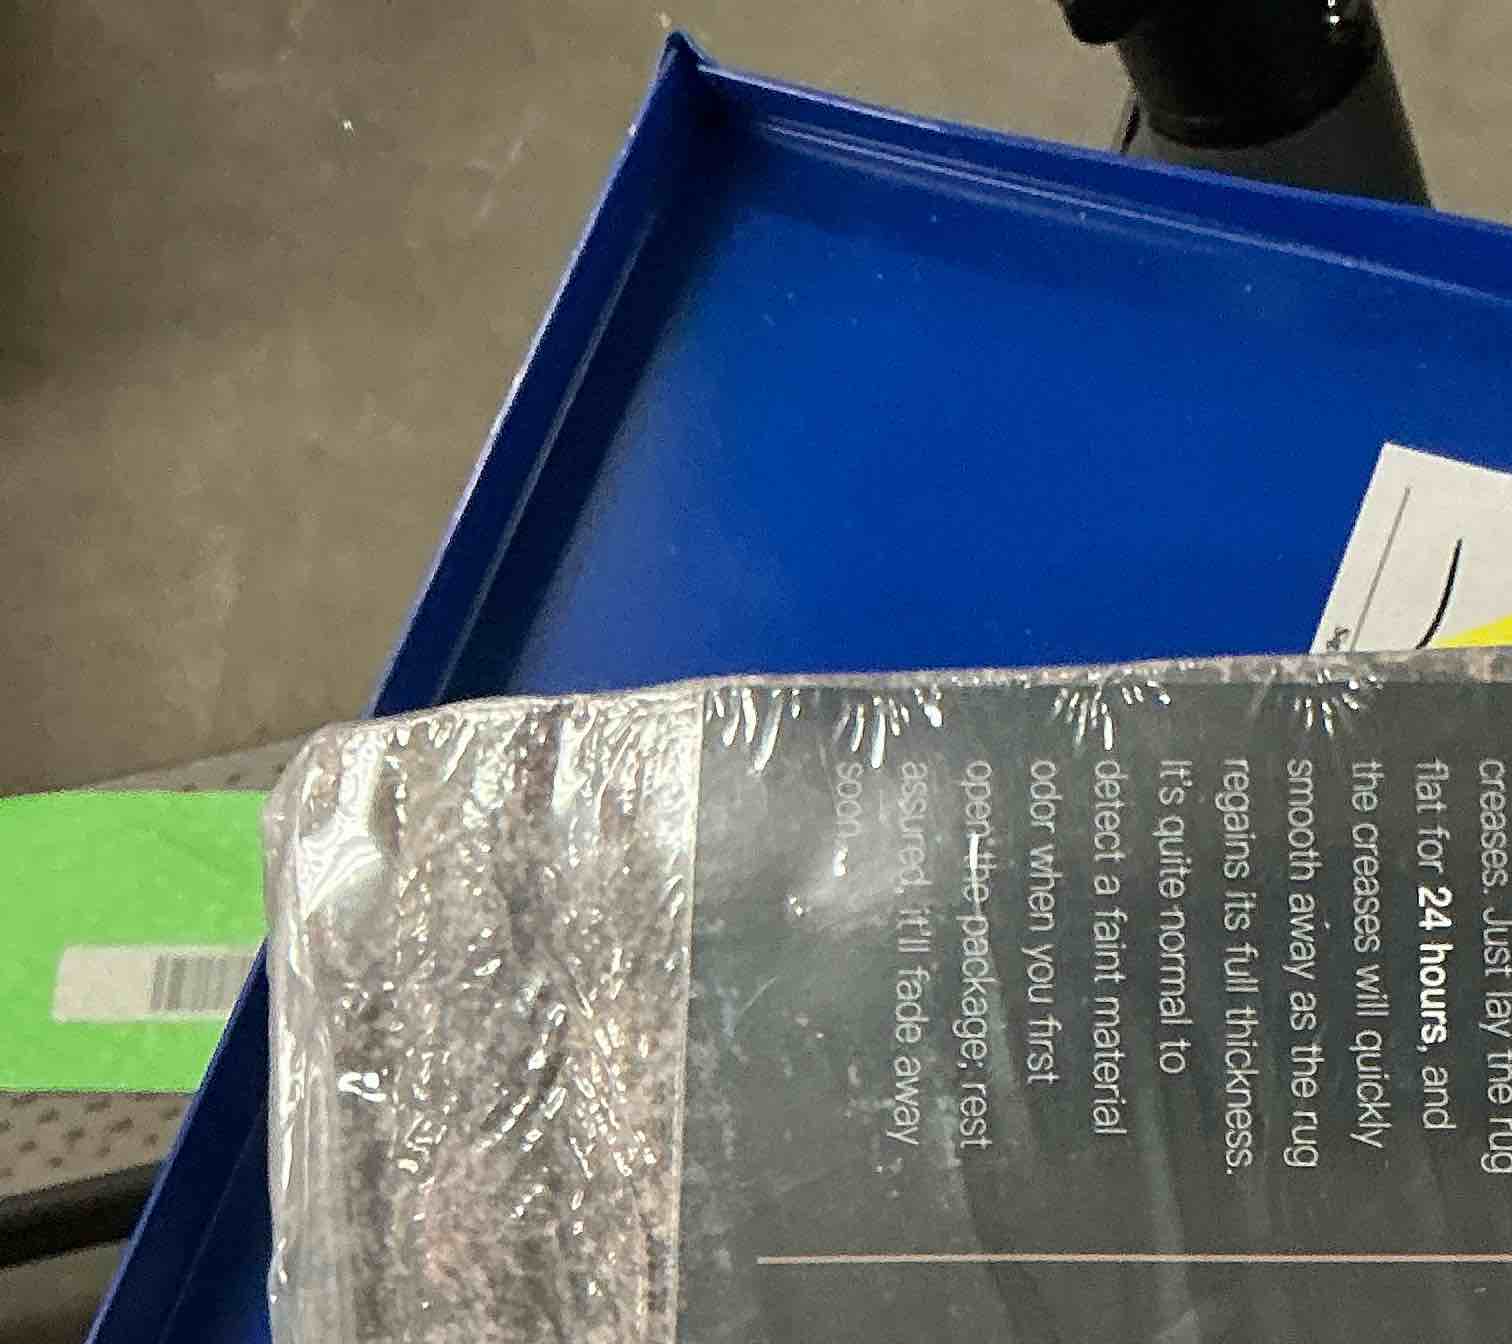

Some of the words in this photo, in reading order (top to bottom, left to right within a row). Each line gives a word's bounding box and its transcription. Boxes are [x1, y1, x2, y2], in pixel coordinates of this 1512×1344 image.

[960, 760, 992, 840] open
[1030, 759, 1062, 834] odor
[1093, 760, 1127, 862] detect
[1158, 760, 1192, 805] It's
[1215, 758, 1256, 878] regains
[1287, 759, 1323, 880] smooth
[1352, 759, 1384, 811] the
[1415, 757, 1449, 813] flat
[895, 760, 932, 893] assured,
[1152, 815, 1192, 897] quite
[1417, 824, 1450, 874] for
[1479, 758, 1508, 894] creases.
[963, 853, 997, 902] the
[1028, 844, 1063, 931] when
[1094, 875, 1120, 895] a
[1224, 891, 1256, 930] its
[1352, 822, 1380, 952] creases
[1418, 882, 1452, 930] 24
[896, 904, 932, 952] it'll
[1093, 906, 1128, 984] faint
[1282, 893, 1314, 981] away
[895, 963, 930, 1043] fade
[953, 913, 998, 1067] package;
[1021, 944, 1056, 1003] you
[1159, 909, 1194, 1024] normal
[1224, 942, 1259, 992] full
[1356, 964, 1390, 1016] will
[1416, 940, 1454, 1053] hours,
[1027, 1014, 1062, 1084] first
[1290, 992, 1318, 1031] as
[1092, 995, 1127, 1134] material
[1160, 1038, 1191, 1073] to
[1224, 1004, 1259, 1176] thickness.
[1290, 1036, 1325, 1096] the
[1348, 1029, 1392, 1152] quickly
[887, 1056, 921, 1144] away
[960, 1083, 992, 1149] rest
[1422, 1065, 1457, 1128] and
[1283, 1107, 1318, 1166] rug
